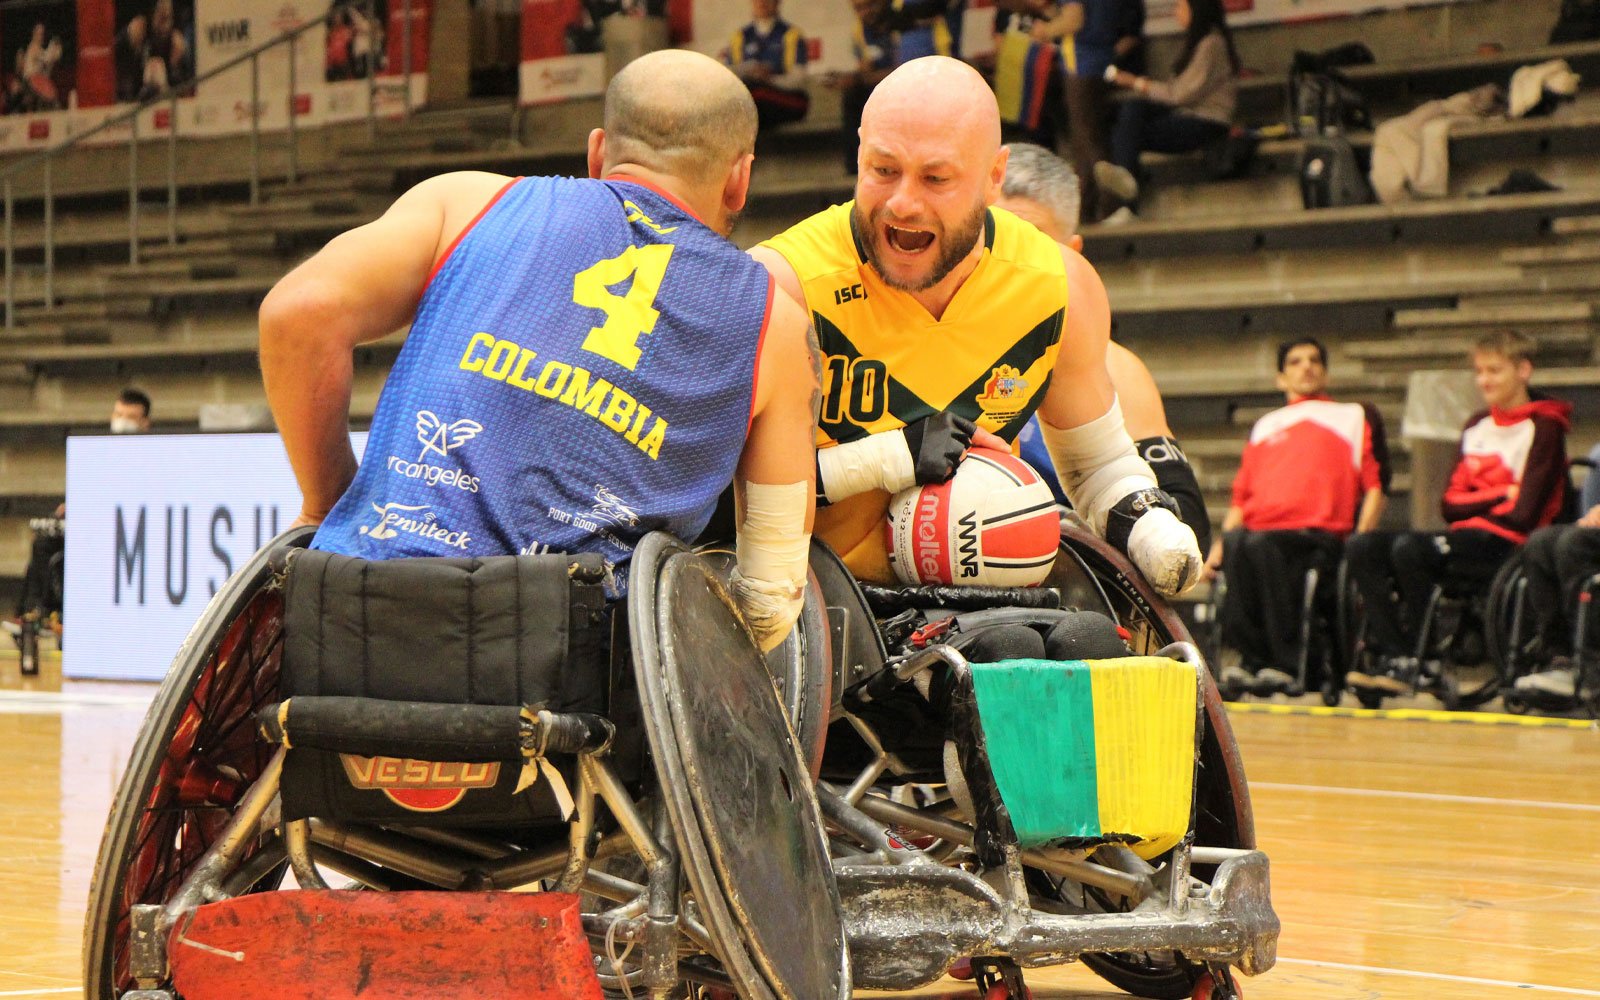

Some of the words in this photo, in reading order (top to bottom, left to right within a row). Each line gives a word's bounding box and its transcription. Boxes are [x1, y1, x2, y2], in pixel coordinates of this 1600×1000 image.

[573, 243, 675, 372] 4
[459, 332, 669, 460] COLOMBIA
[825, 357, 888, 423] 10
[573, 517, 598, 533] GOOD
[1116, 572, 1150, 612] KENDA
